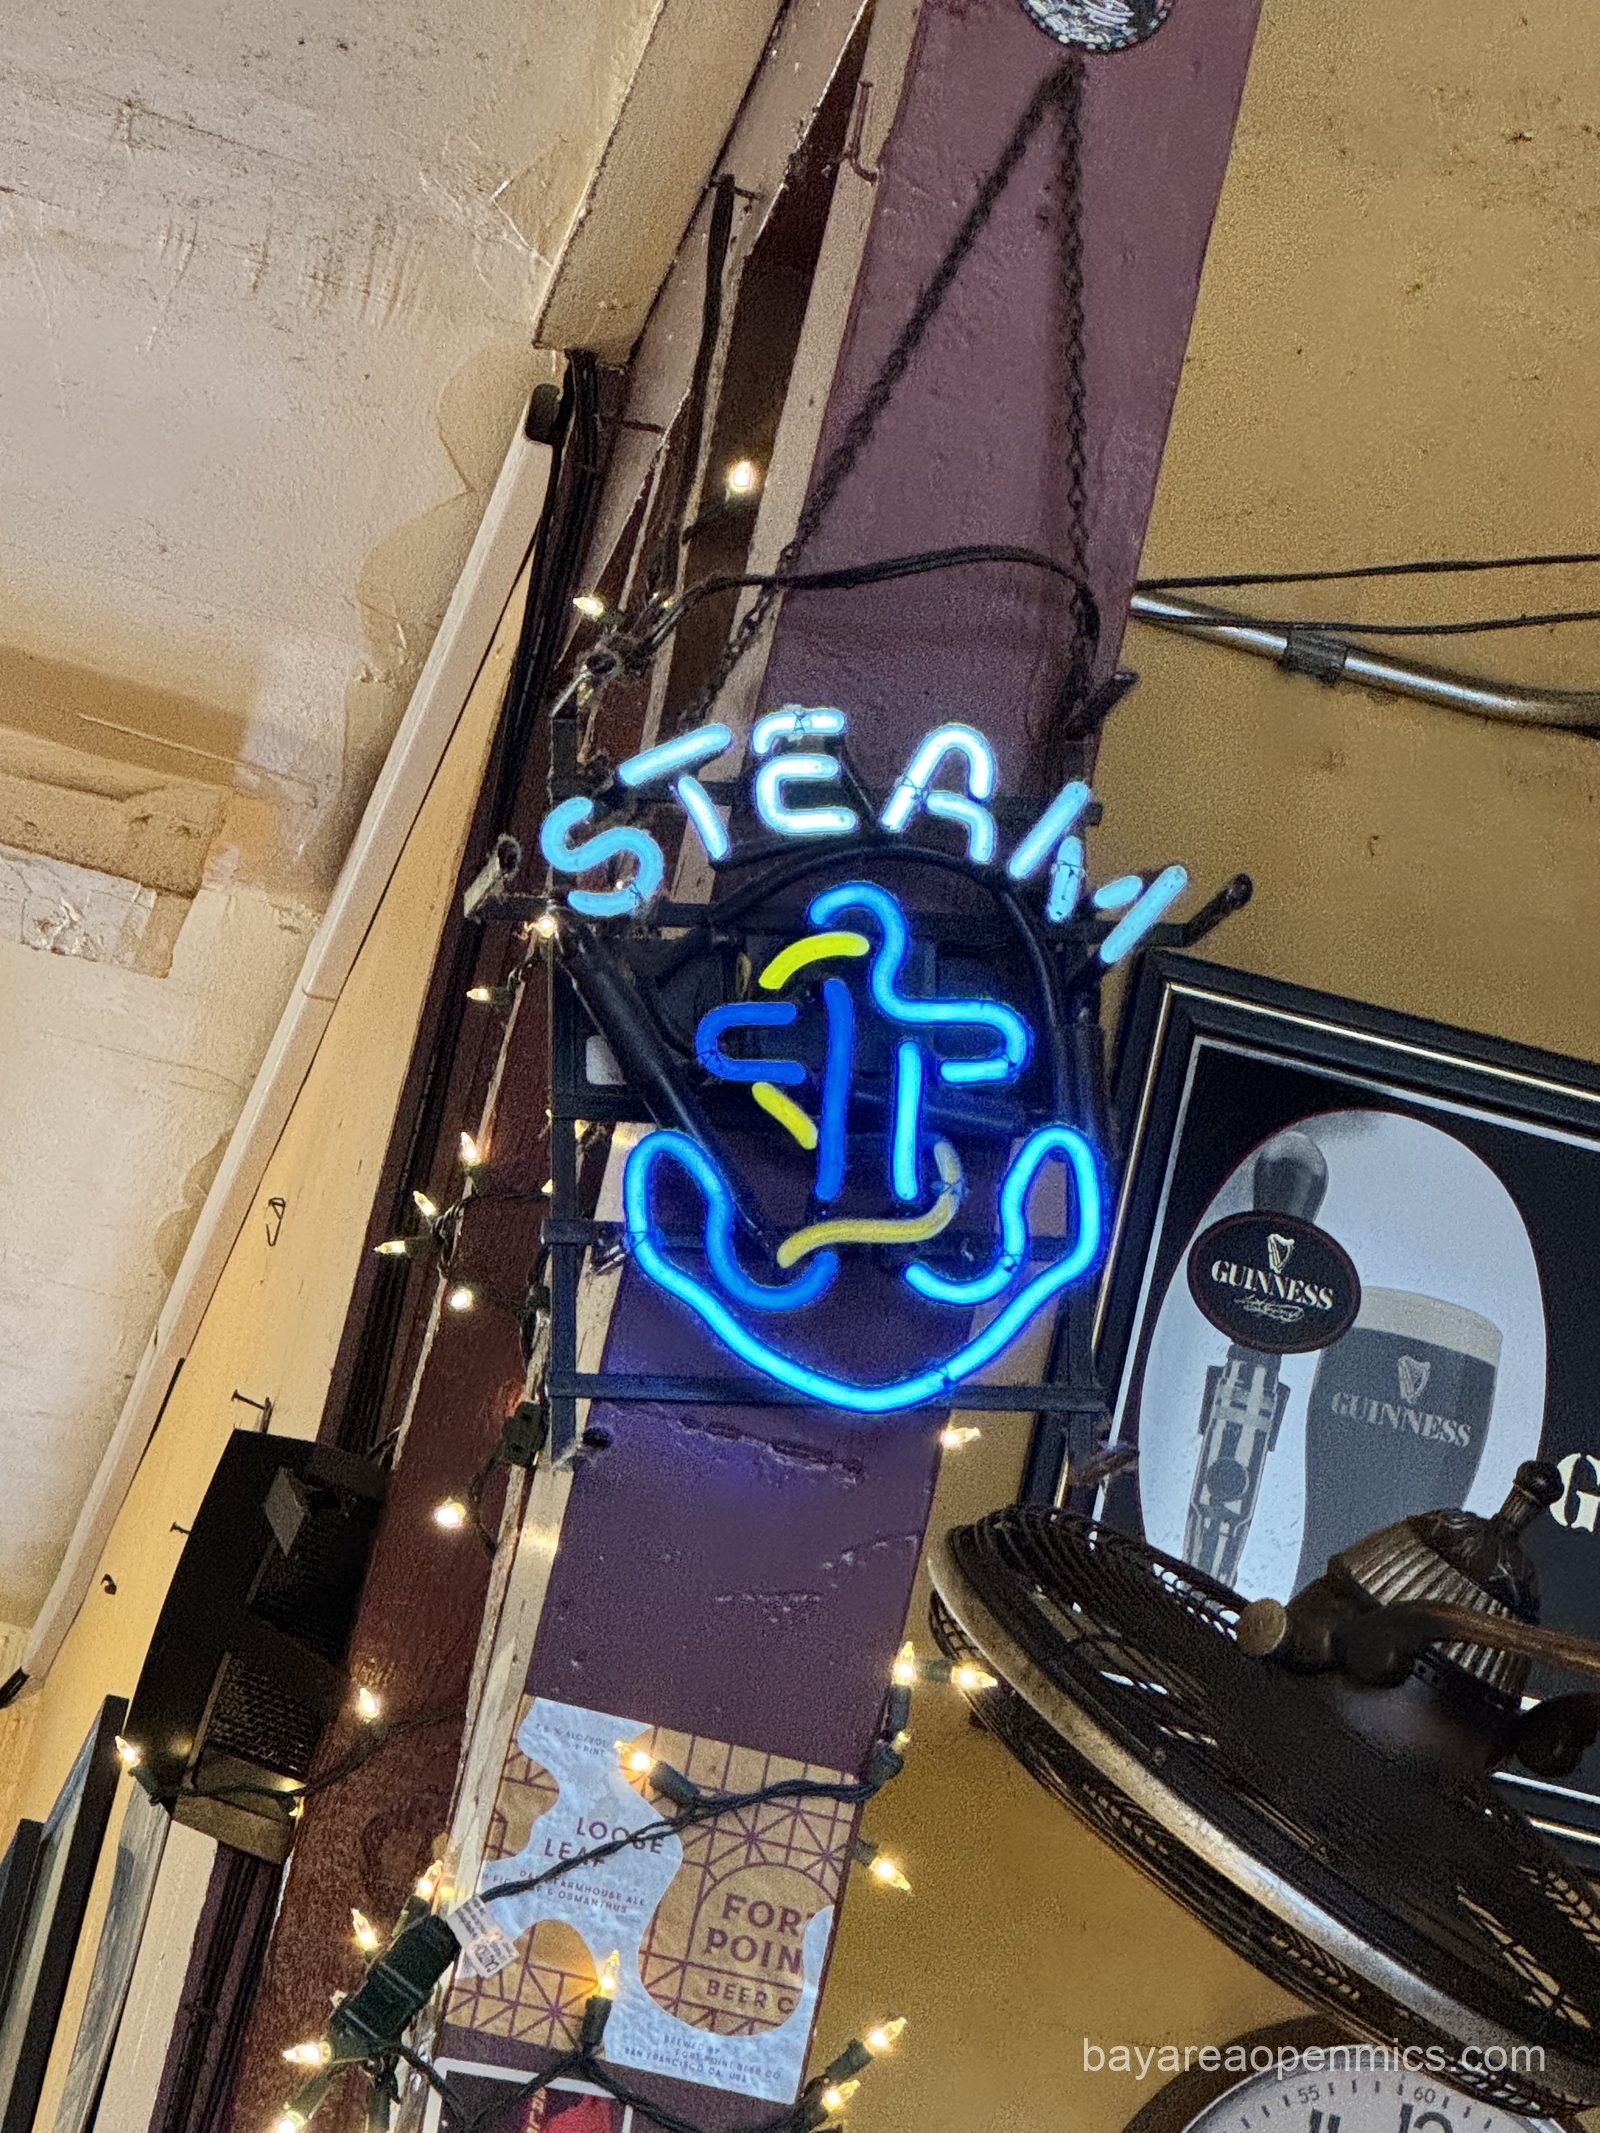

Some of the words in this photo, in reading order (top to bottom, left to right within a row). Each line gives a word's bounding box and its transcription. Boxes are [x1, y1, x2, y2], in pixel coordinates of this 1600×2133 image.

[540, 707, 1188, 964] STEAM
[1211, 1260, 1333, 1310] GUINNESS
[1331, 1393, 1472, 1449] GUINNESS
[558, 1891, 627, 1914] OSMANTHUS
[722, 1892, 815, 1936] FOR
[706, 1979, 767, 2009] BEER
[1298, 2084, 1320, 2105] 55
[1413, 2085, 1436, 2104] 60
